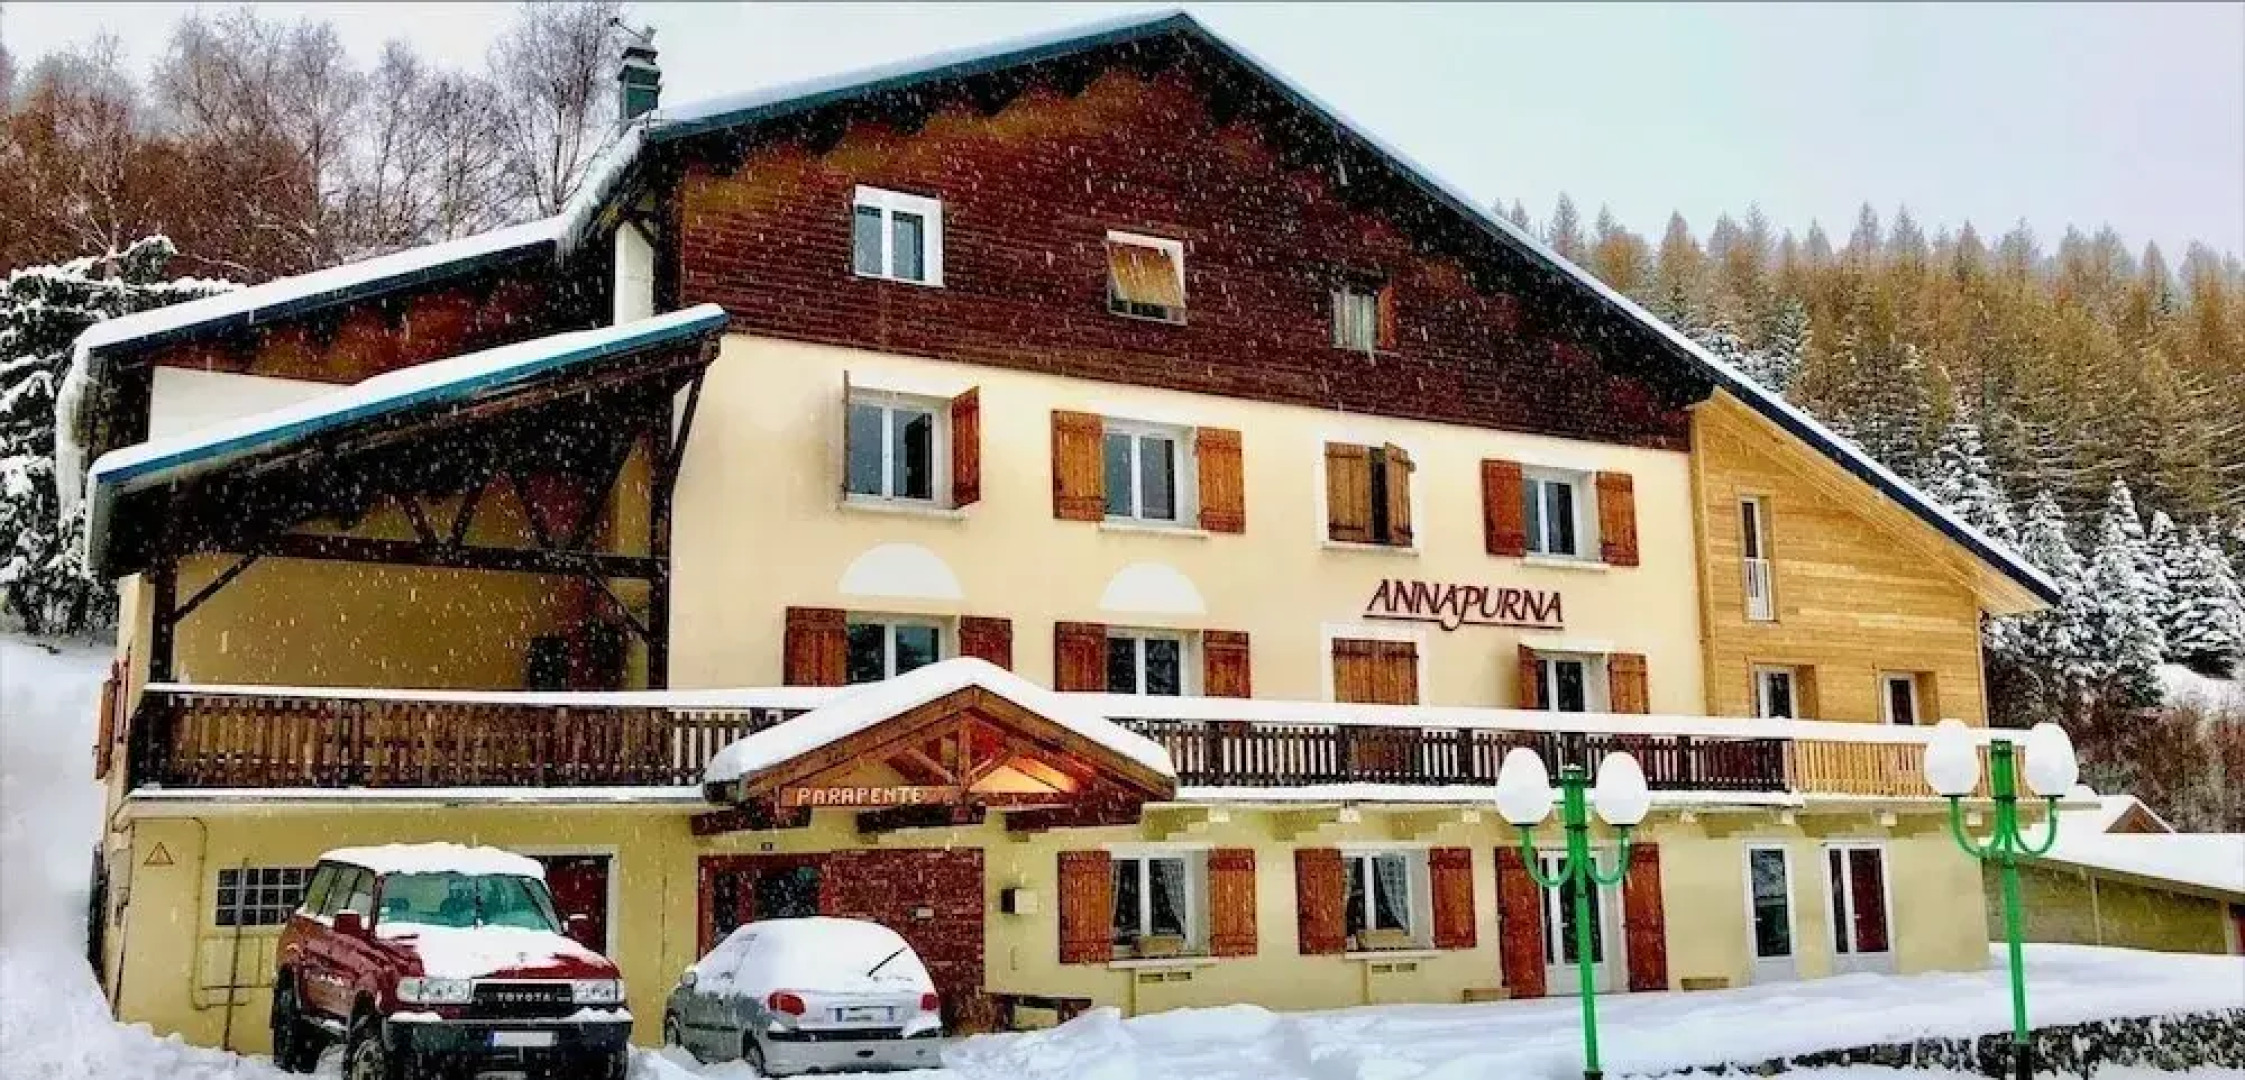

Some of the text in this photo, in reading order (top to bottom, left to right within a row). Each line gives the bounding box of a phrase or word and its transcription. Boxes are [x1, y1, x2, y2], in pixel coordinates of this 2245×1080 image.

[1366, 579, 1563, 631] ANNAPURNA
[797, 787, 922, 806] PARAPENTE
[496, 991, 551, 1002] TOYOTA
